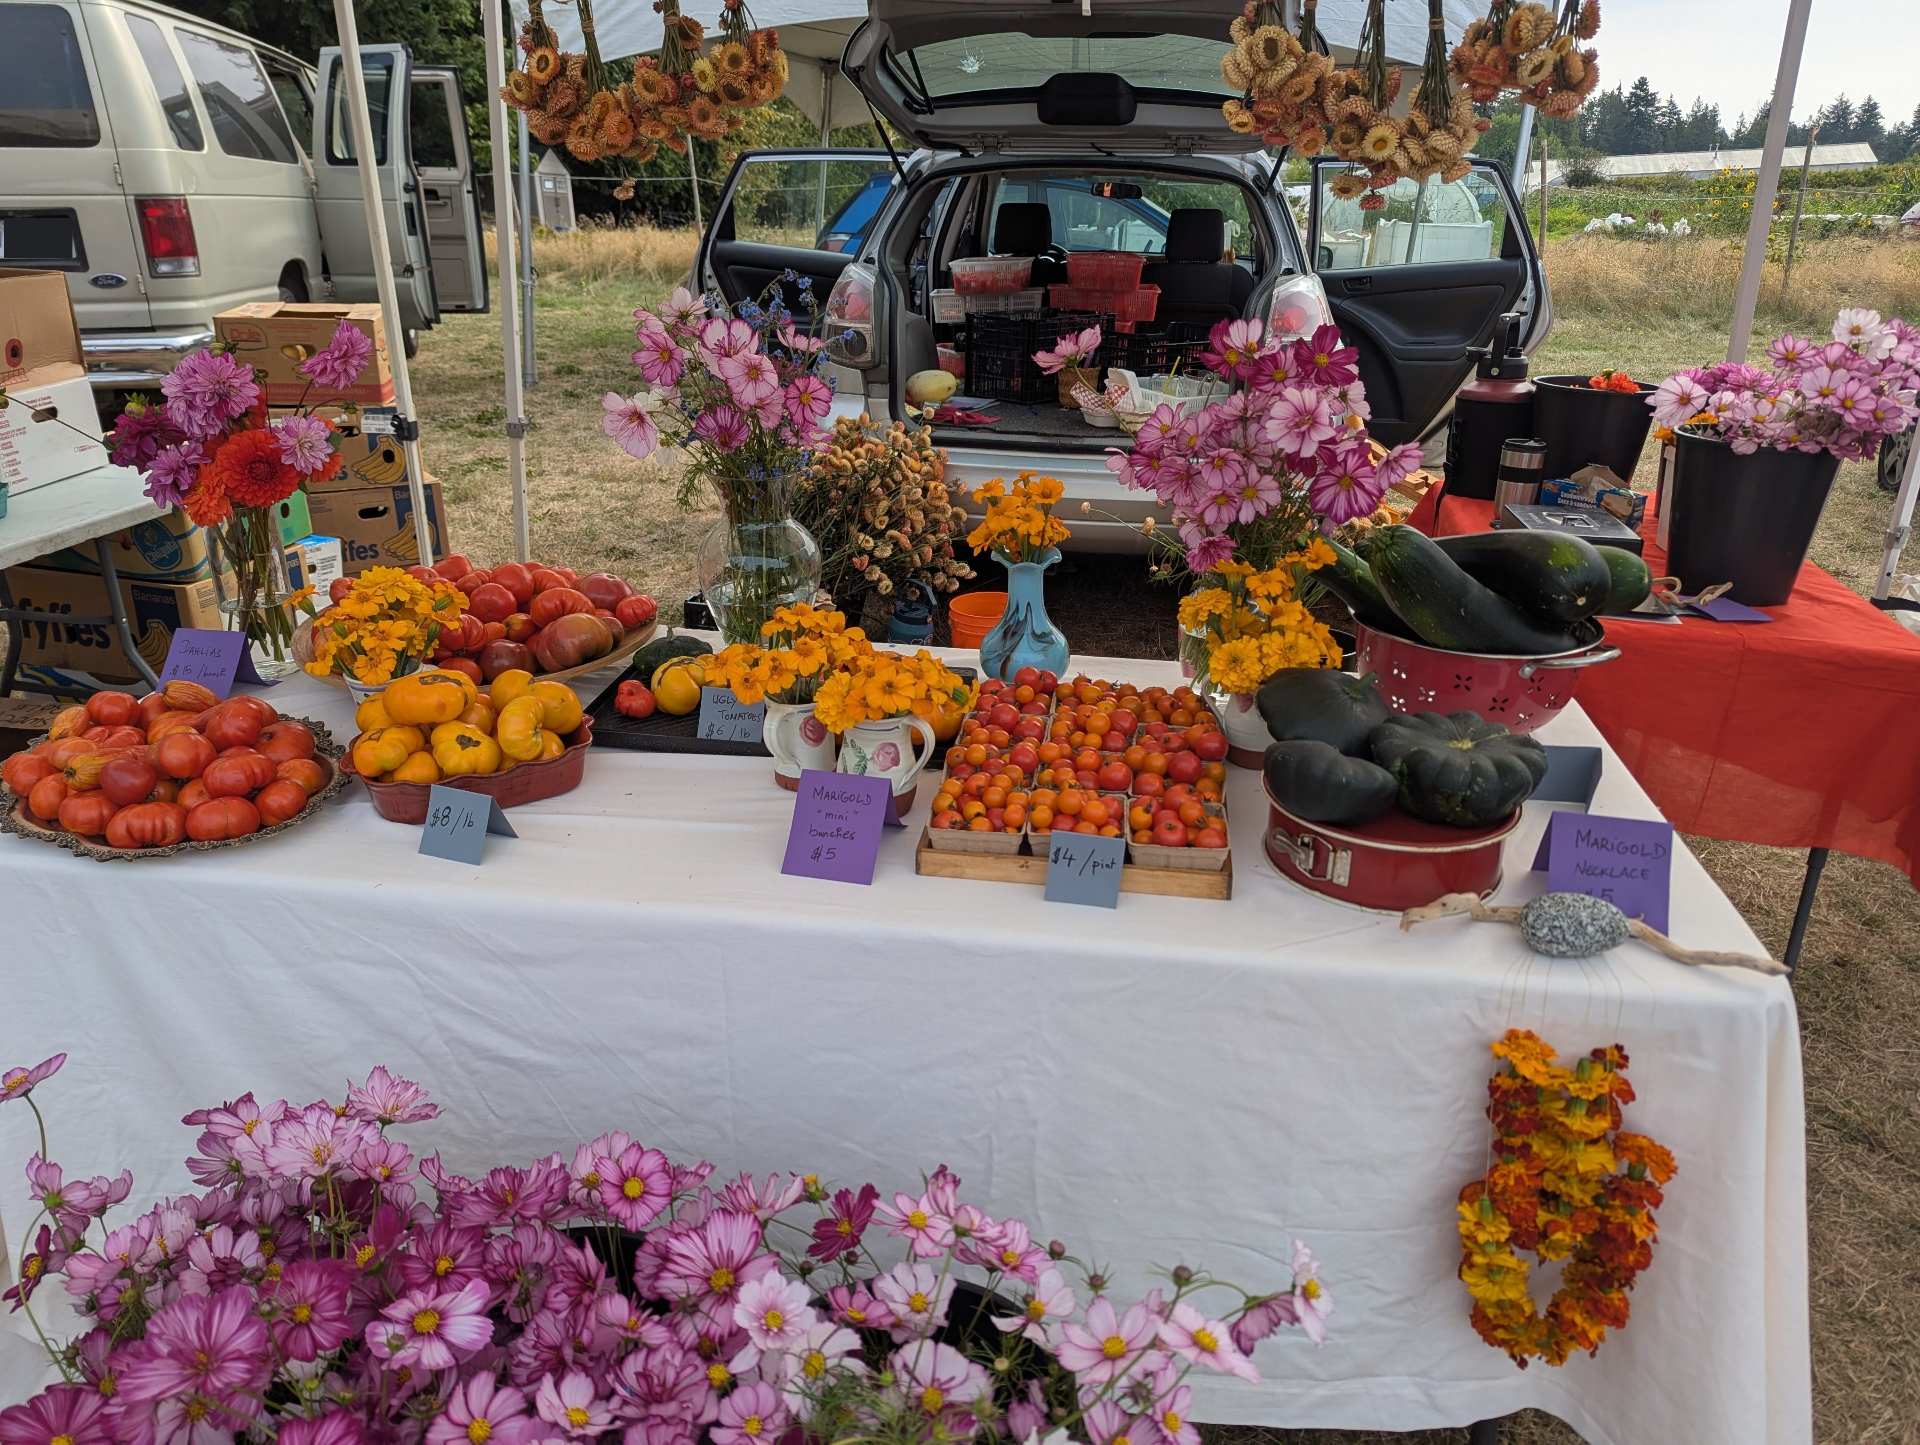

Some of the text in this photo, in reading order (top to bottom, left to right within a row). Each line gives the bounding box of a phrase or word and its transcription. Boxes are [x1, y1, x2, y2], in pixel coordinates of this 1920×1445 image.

[97, 275, 118, 285] Ford
[229, 328, 262, 341] Dole
[395, 488, 433, 500] Bans
[144, 540, 180, 564] Chiquita
[133, 589, 176, 605] Bananas
[712, 693, 739, 710] UGLY
[717, 709, 763, 723] TOMATOES
[704, 721, 725, 740] $6
[808, 823, 857, 841] bunches
[1573, 860, 1651, 881] NECKLACE
